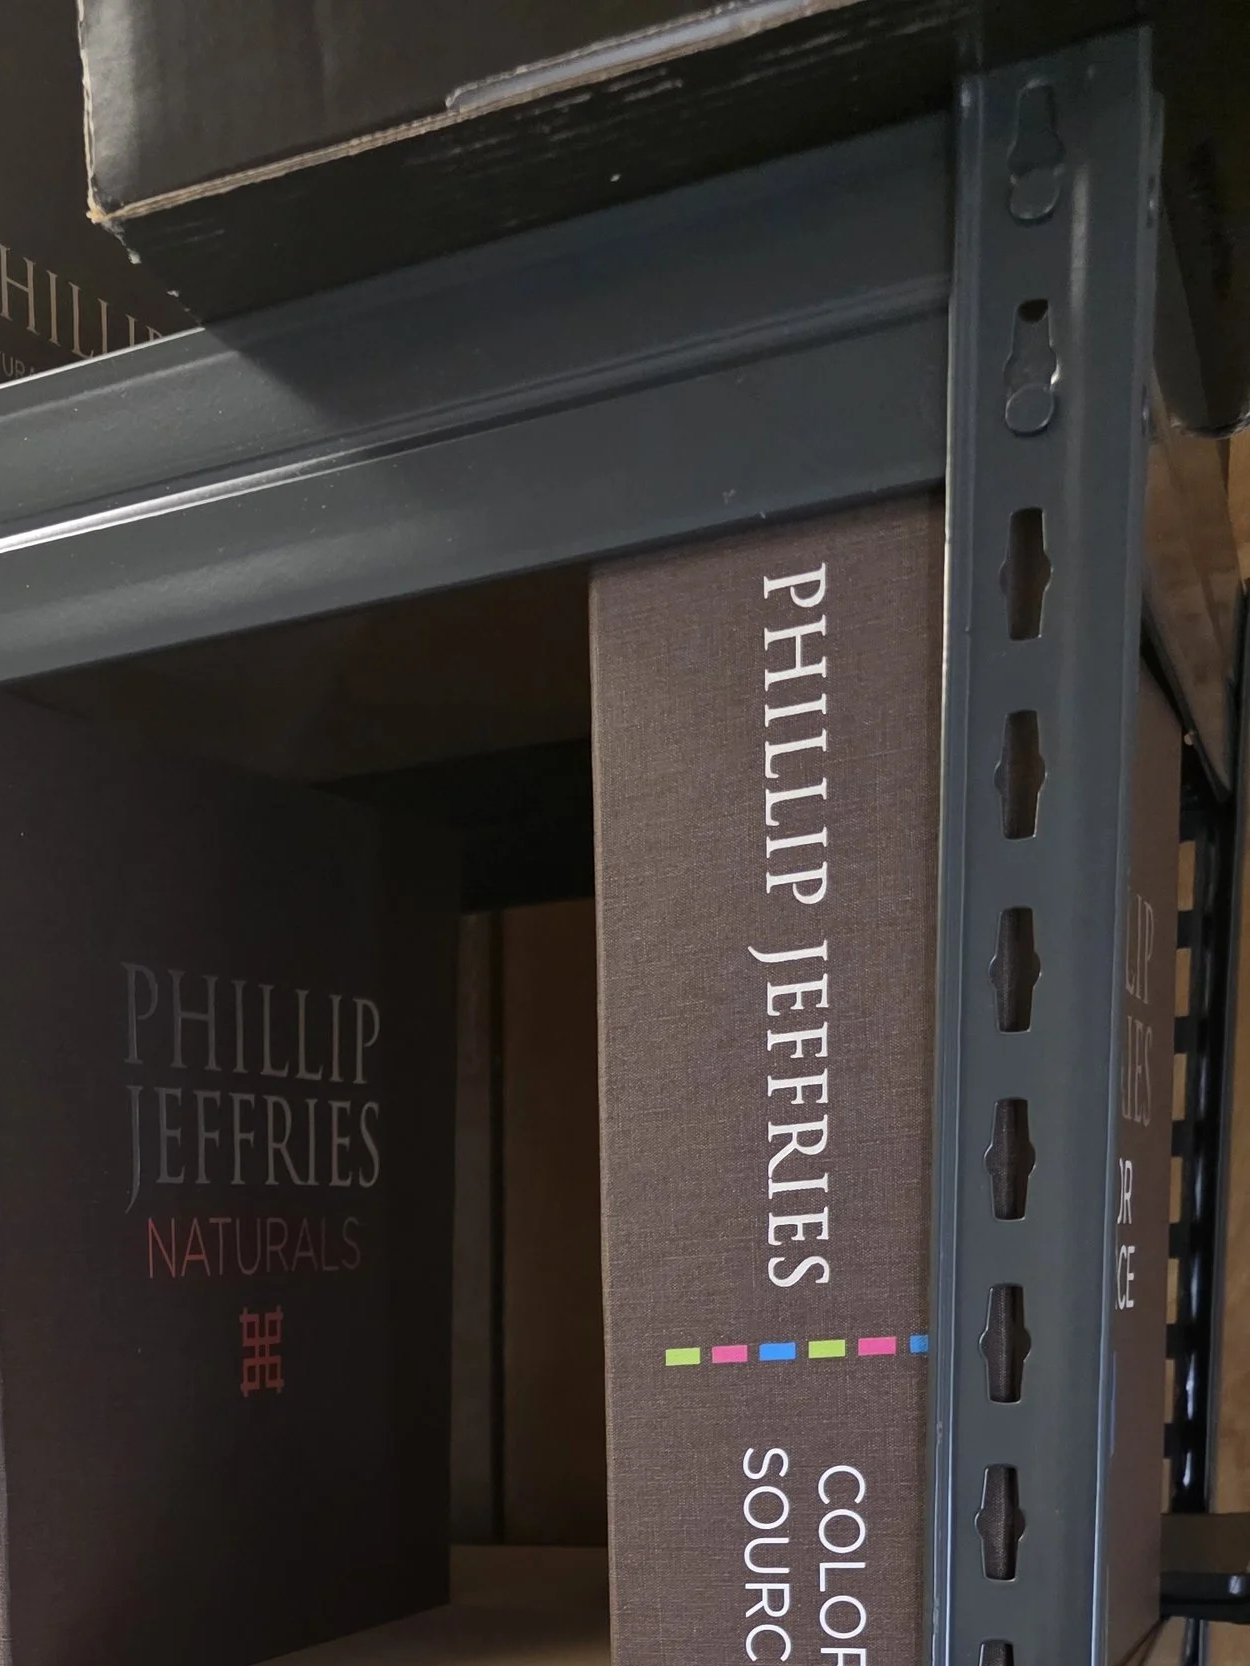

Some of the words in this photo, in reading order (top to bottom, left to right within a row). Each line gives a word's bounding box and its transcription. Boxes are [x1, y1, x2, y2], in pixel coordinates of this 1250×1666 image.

[762, 562, 829, 906] PHILLIP
[120, 960, 381, 1085] PHILLIP
[124, 1084, 381, 1215] JEFFRIES
[747, 940, 831, 1292] JEFFRIES
[145, 1216, 362, 1279] NATURALS
